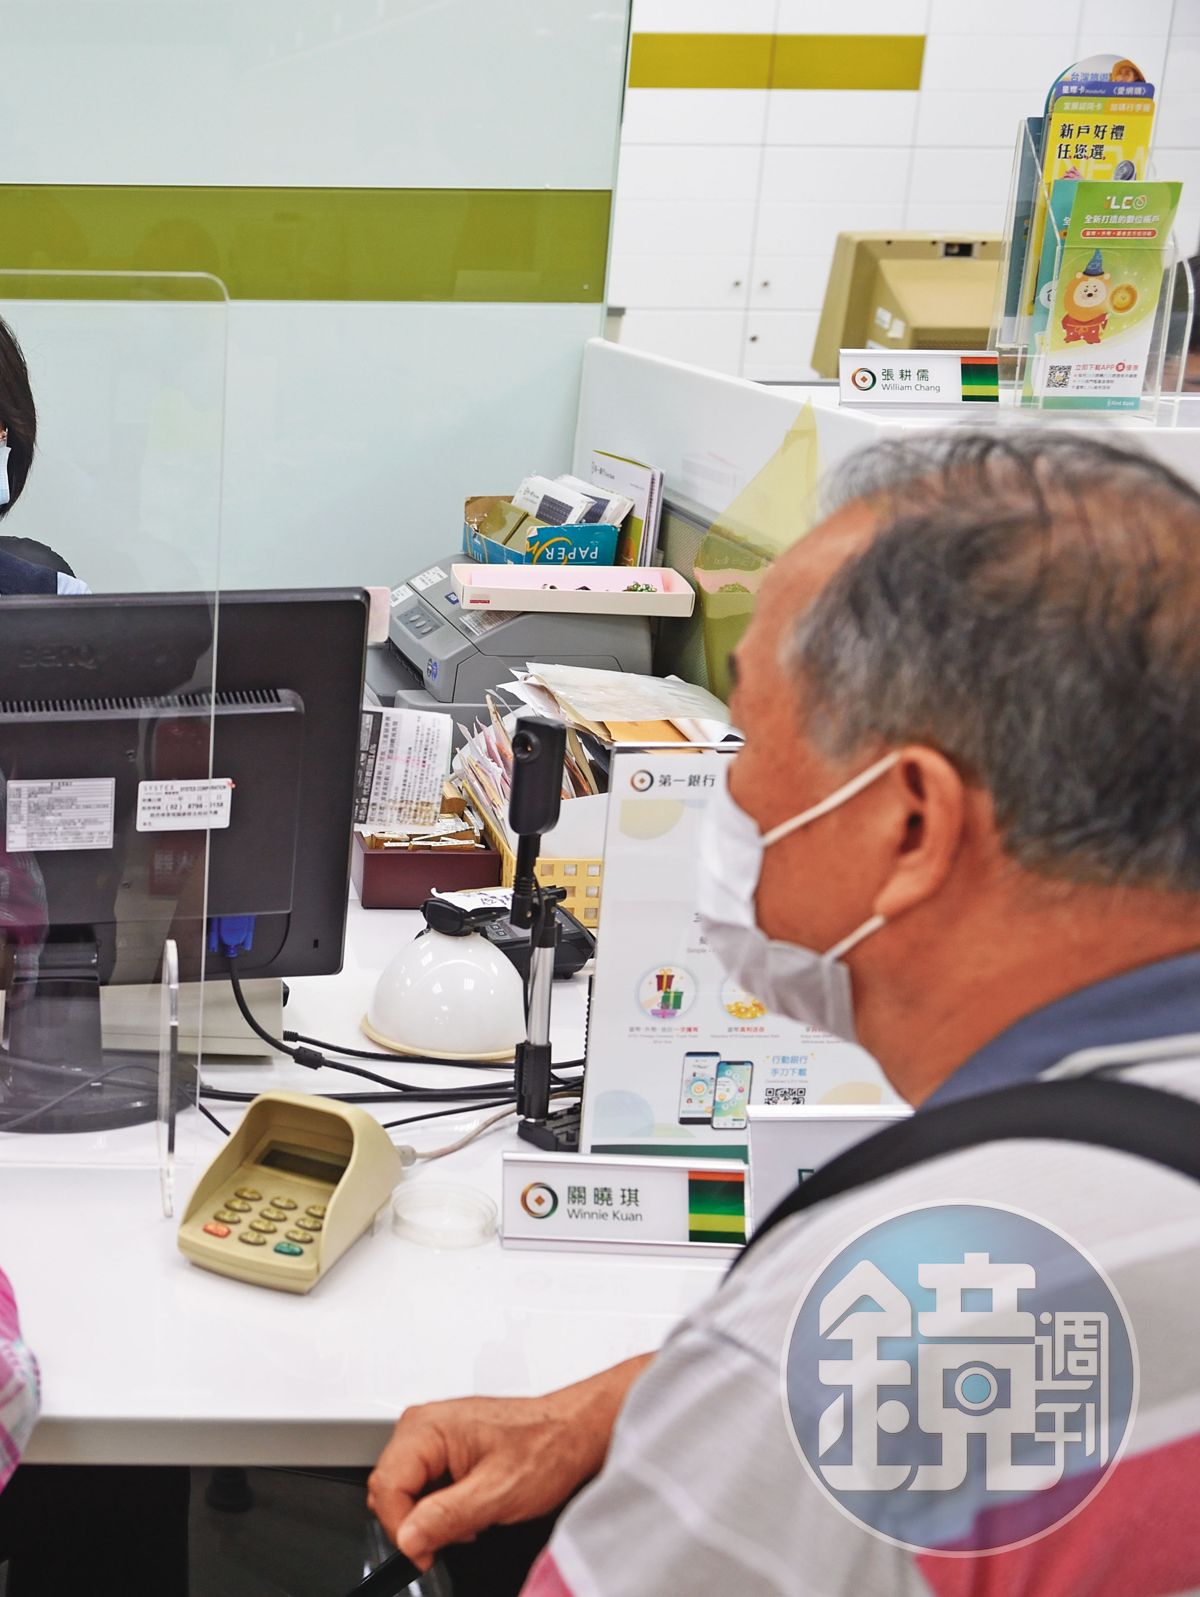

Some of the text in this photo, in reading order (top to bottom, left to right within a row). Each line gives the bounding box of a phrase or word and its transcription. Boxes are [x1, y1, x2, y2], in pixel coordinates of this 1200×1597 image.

[1060, 123, 1125, 140] 新戶好禮
[881, 368, 929, 382] 張耕儒
[881, 383, 941, 394] William Chang
[545, 546, 599, 560] PAPER
[658, 773, 716, 788] 第一銀行
[772, 1055, 809, 1065] 行動銀行
[566, 1208, 643, 1222] Winnie Kuan
